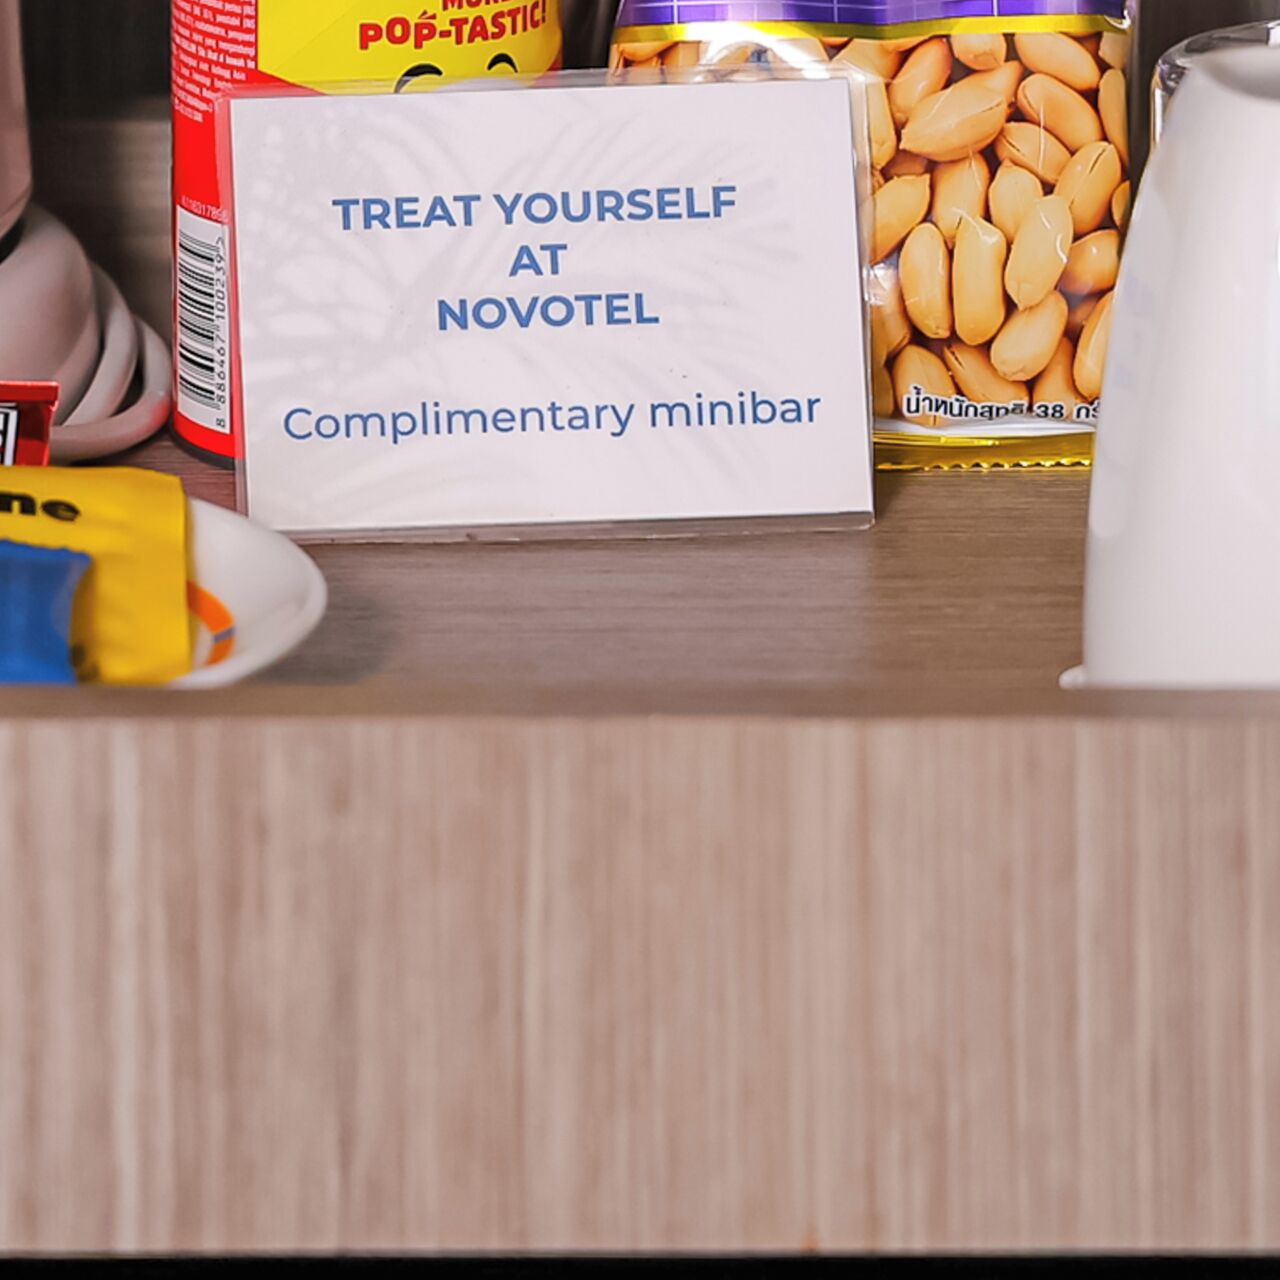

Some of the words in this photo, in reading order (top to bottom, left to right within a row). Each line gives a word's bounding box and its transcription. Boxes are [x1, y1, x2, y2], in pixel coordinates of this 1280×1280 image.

[331, 194, 481, 231] TREAT
[493, 185, 737, 225] YOURSELF
[508, 243, 568, 277] AT
[436, 292, 660, 331] NOVOTEL
[283, 399, 635, 445] Complimentary
[650, 391, 821, 428] minibar
[1035, 403, 1064, 419] 38
